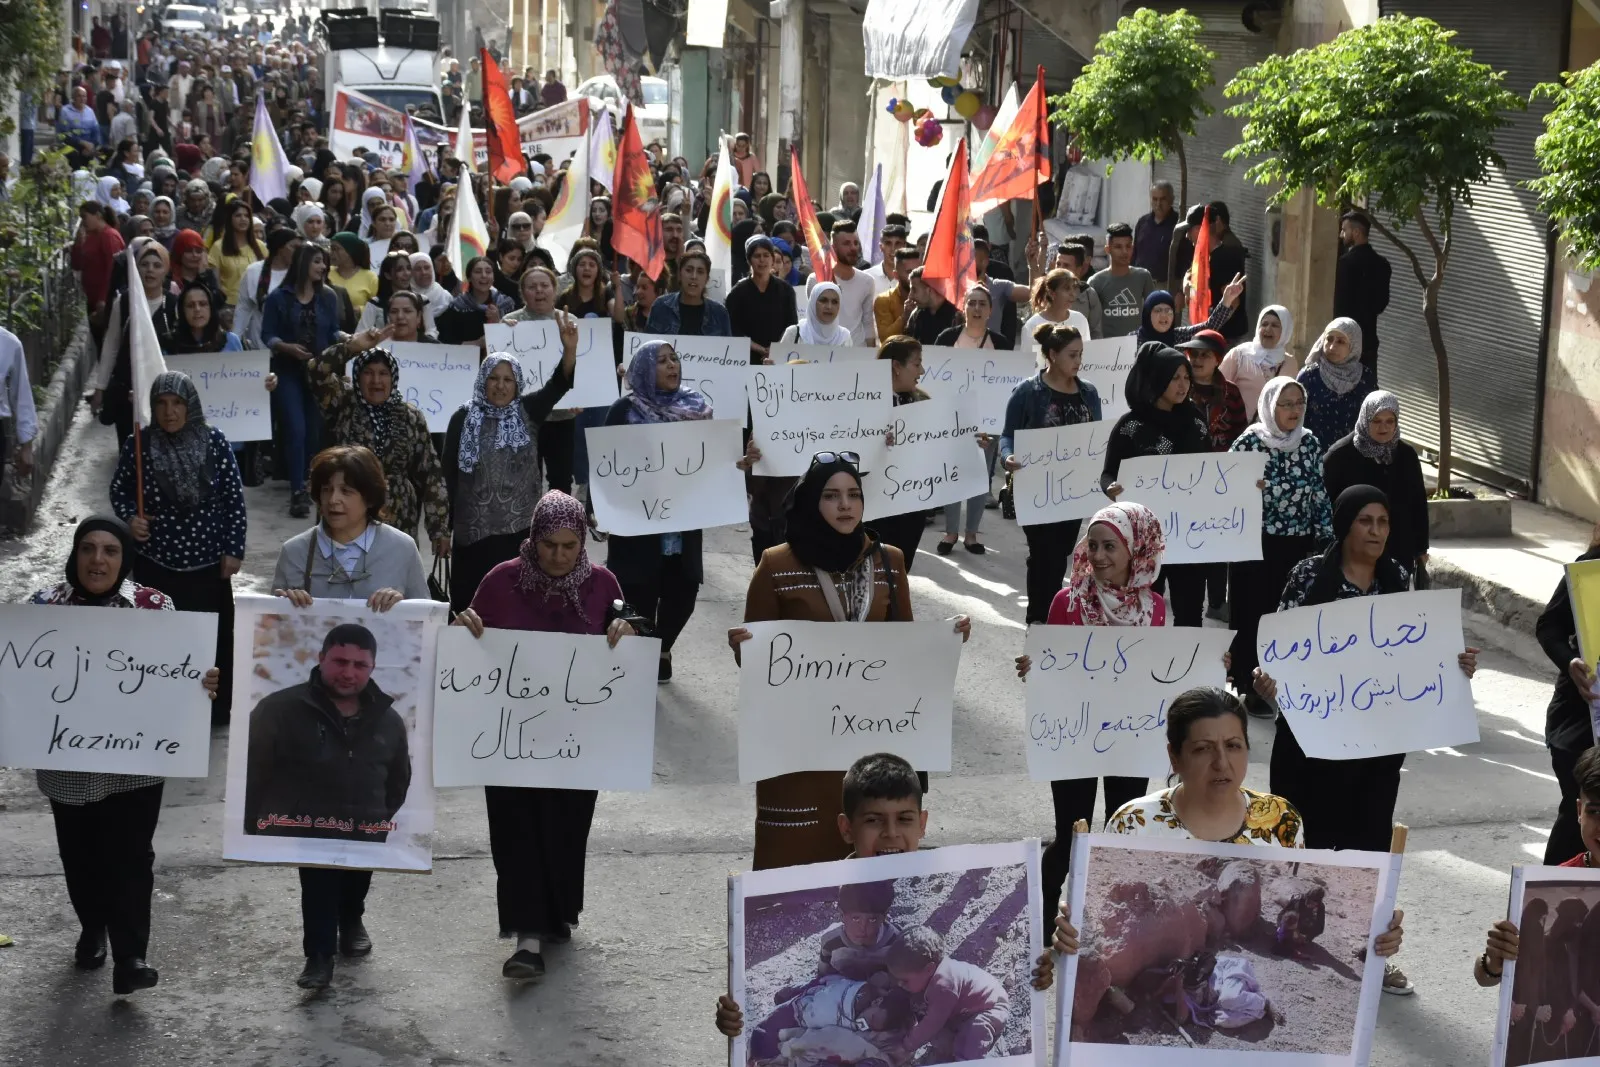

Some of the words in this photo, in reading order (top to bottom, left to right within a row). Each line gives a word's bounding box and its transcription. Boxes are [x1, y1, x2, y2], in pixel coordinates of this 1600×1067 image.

[1103, 306, 1140, 317] adidas
[790, 368, 882, 403] berxwedana
[920, 358, 953, 384] Na
[958, 368, 976, 395] ji
[245, 407, 261, 417] re
[893, 410, 980, 446] Berxwedana
[982, 416, 997, 426] re
[675, 441, 705, 476] لا
[883, 462, 960, 502] Şengalê
[1214, 460, 1239, 495] لا
[1260, 608, 1359, 663] مقاومة
[1369, 602, 1428, 657] تحيا
[0, 629, 58, 670] Na
[51, 645, 91, 704] ji
[105, 649, 201, 695] Siyaseta
[440, 642, 550, 699] مقاومة
[767, 632, 887, 687] Bimire
[1150, 642, 1201, 684] لا
[564, 647, 626, 712] تحيا
[471, 706, 581, 760] شنكال
[831, 697, 923, 736] îxanet
[154, 738, 181, 755] re
[256, 813, 313, 830] شنكالي
[314, 816, 354, 832] زردشت
[357, 819, 398, 834] الشهيد
